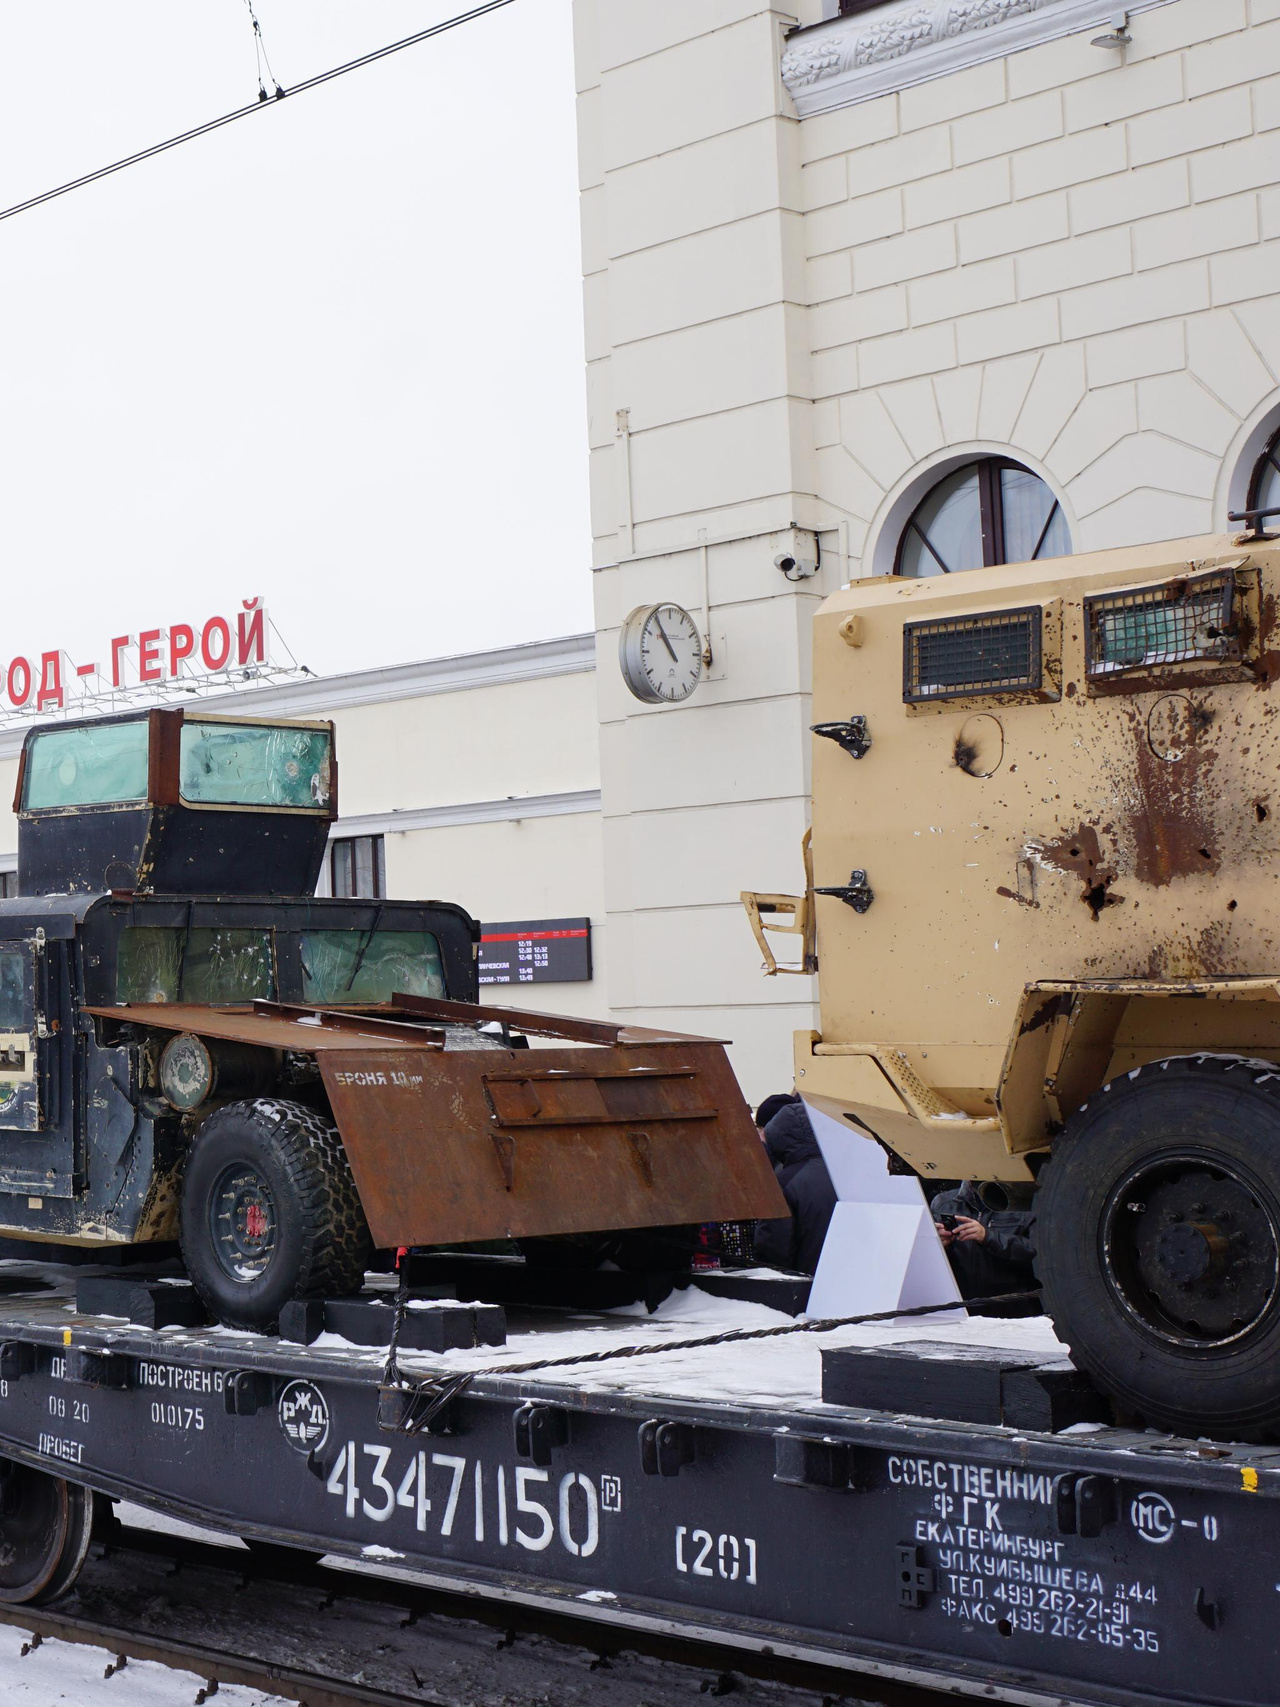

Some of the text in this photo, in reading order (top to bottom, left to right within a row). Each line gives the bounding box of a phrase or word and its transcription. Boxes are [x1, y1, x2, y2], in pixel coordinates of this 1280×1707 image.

[111, 596, 269, 688] ГЕРОЙ
[334, 1072, 388, 1086] БРОНЯ
[151, 1402, 205, 1431] 010175
[282, 1390, 327, 1425] РЖД
[38, 1433, 86, 1464] ПРОБЕГ
[326, 1440, 600, 1558] 43471150
[914, 1519, 1065, 1563] ЕКАТЕРИНБУРГ
[947, 1573, 1131, 1626] ТЕЛ. 499 262-21-91
[940, 1596, 997, 1625] ФАКС
[1049, 1613, 1160, 1654] 262-05-35
